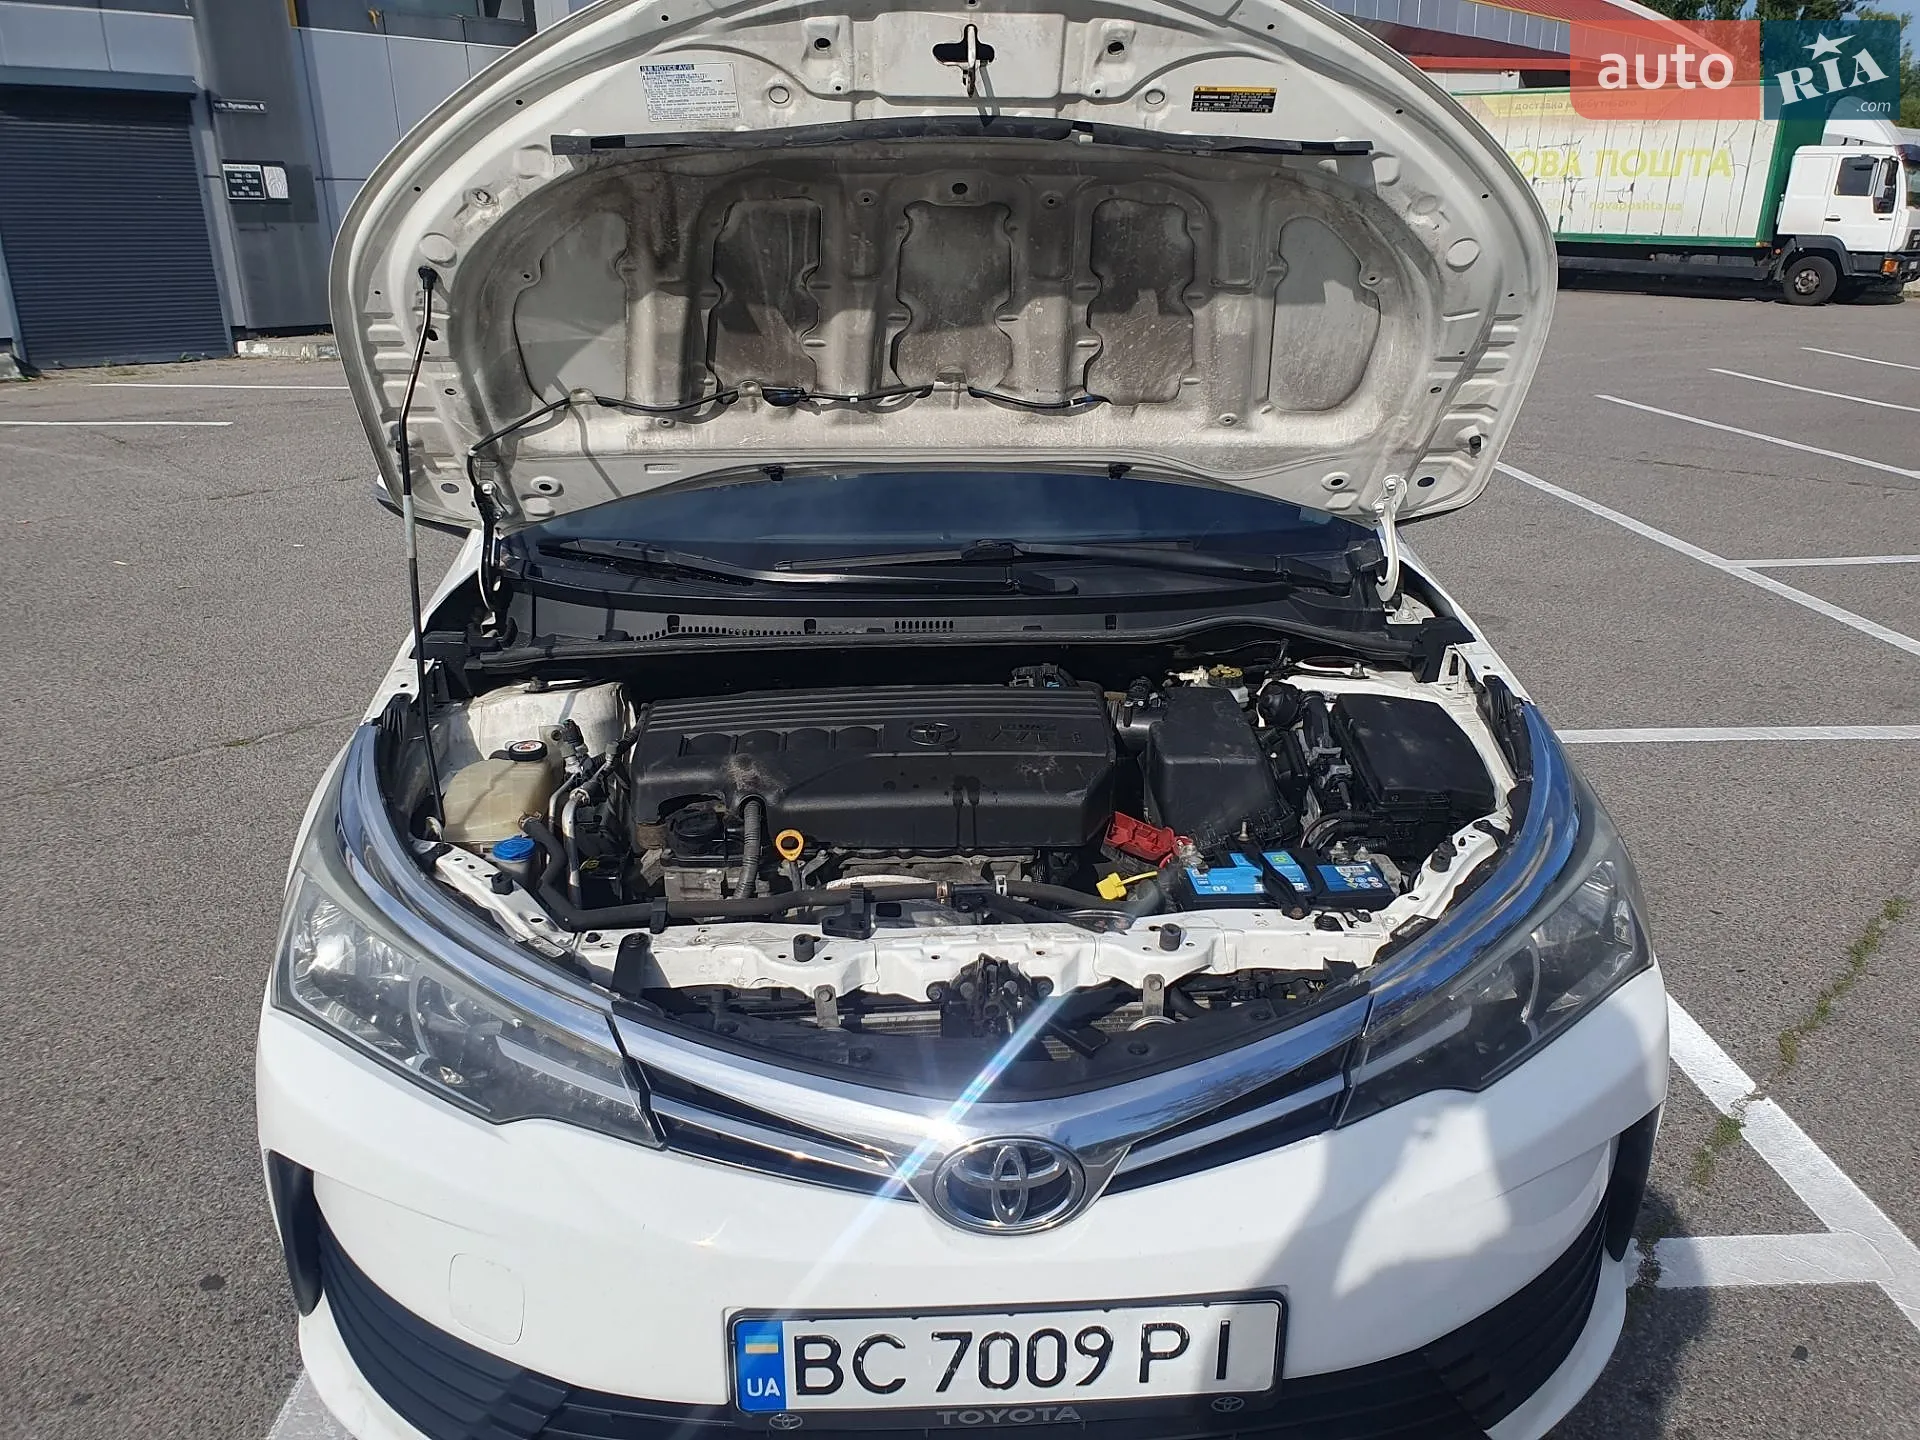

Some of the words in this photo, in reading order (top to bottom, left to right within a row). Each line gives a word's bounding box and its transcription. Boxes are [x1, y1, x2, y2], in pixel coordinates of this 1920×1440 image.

[1515, 101, 1563, 111] доставка
[1506, 149, 1582, 178] ОВА
[1594, 149, 1731, 178] ПОШТА
[793, 1332, 907, 1396] BC
[931, 1324, 1114, 1393] 7009
[746, 1376, 781, 1398] UA
[936, 1405, 1082, 1426] TOYOTA
